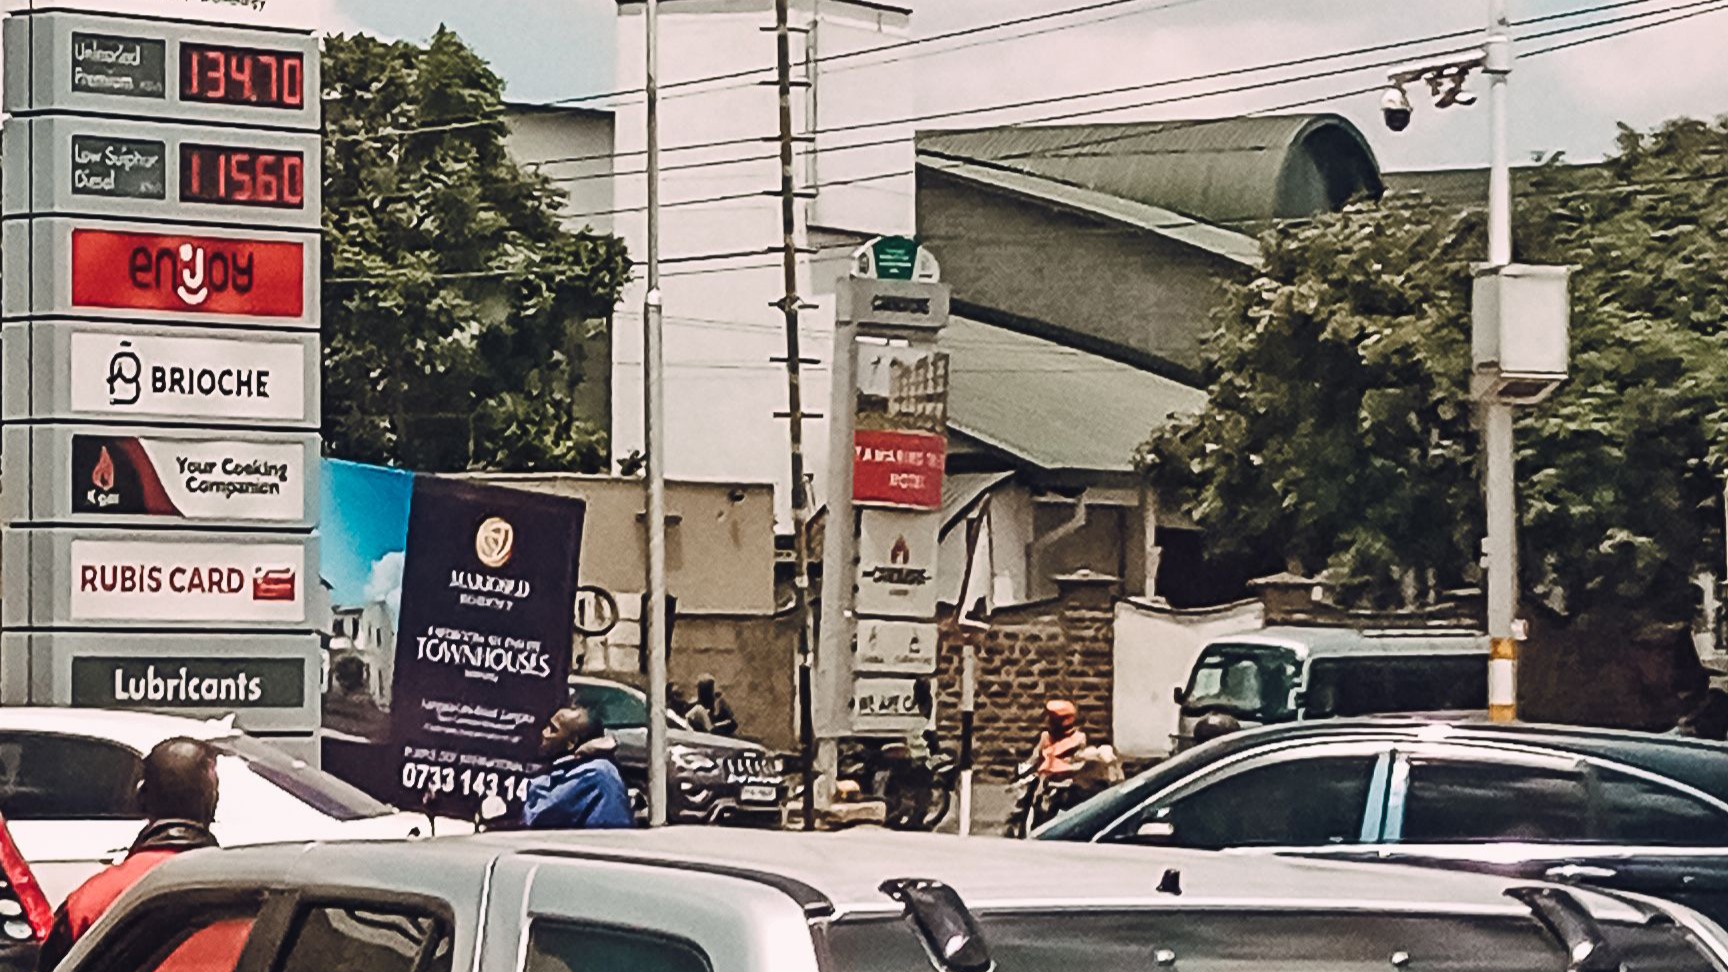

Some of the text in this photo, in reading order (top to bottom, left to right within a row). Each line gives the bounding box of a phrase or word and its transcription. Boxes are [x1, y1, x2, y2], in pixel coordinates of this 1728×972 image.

[129, 243, 254, 297] enjoy
[151, 366, 270, 398] BRIOCHE
[176, 456, 288, 483] Your Cooking
[186, 475, 281, 498] Companion
[80, 564, 245, 594] RUBIS CARD
[417, 636, 551, 678] TOWNHOUSES
[114, 665, 263, 701] Lubricants
[402, 762, 529, 802] 0733 143 14
